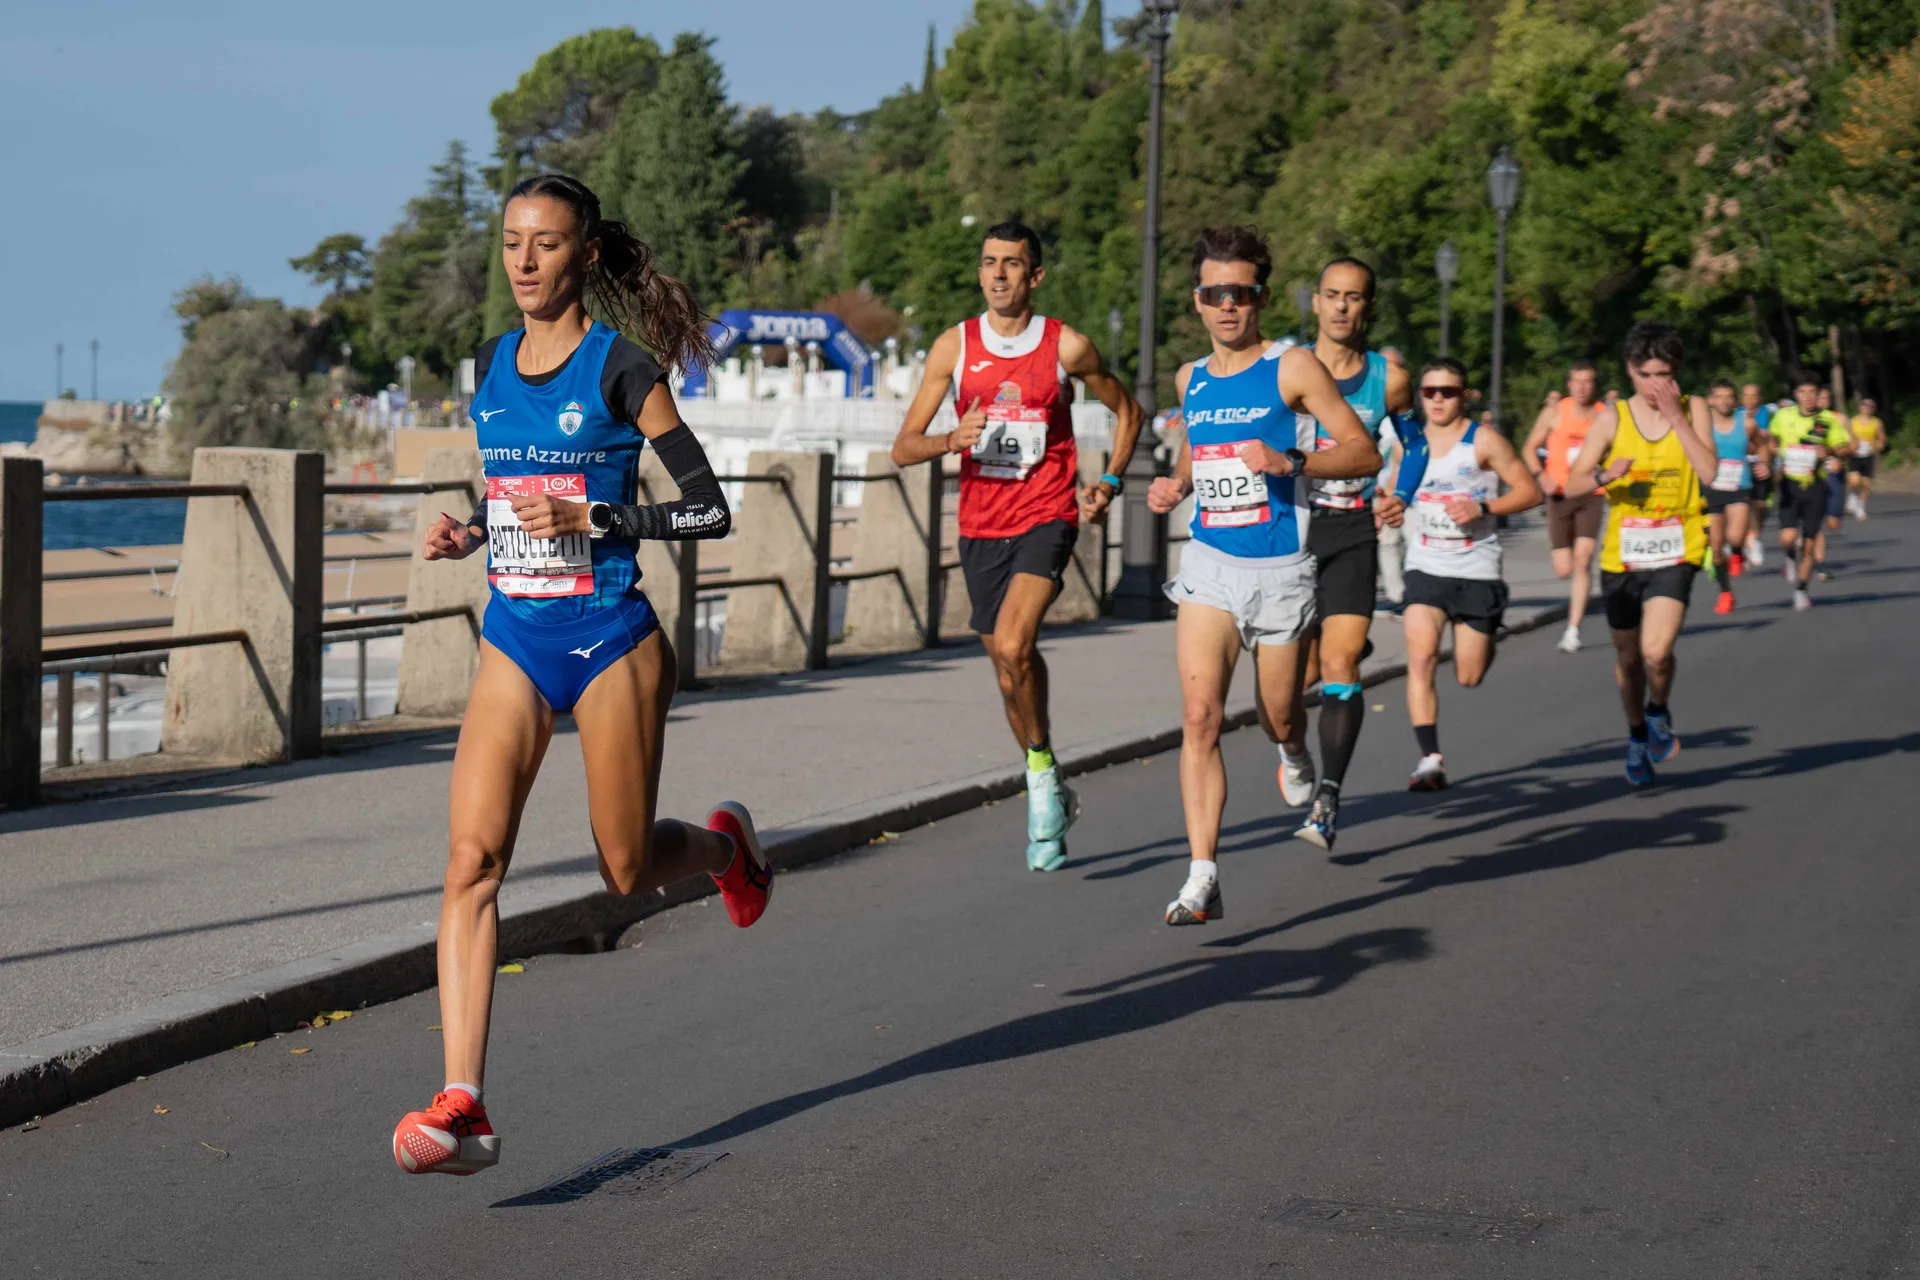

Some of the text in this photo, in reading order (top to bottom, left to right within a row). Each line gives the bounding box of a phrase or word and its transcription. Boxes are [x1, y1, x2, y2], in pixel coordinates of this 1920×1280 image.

[994, 437, 1018, 454] 19
[526, 445, 606, 465] Azzurre
[541, 476, 579, 492] 10K
[1205, 476, 1250, 498] 302
[671, 504, 726, 530] felicetti
[1633, 539, 1672, 554] 420
